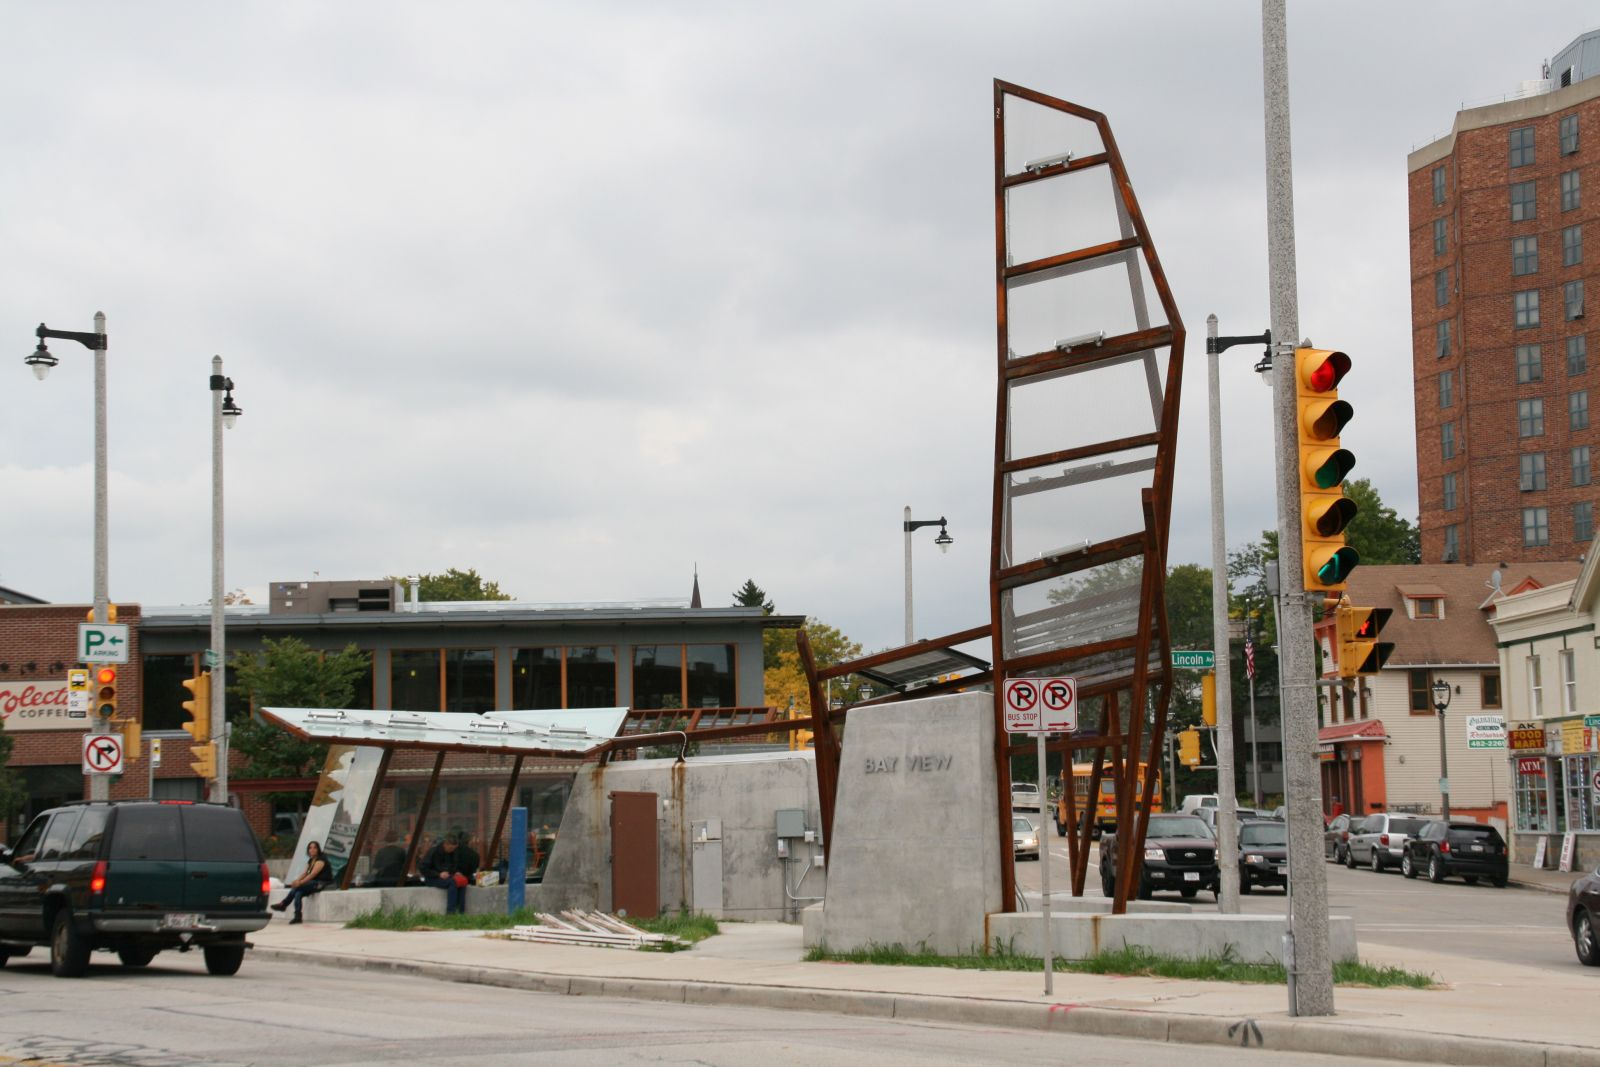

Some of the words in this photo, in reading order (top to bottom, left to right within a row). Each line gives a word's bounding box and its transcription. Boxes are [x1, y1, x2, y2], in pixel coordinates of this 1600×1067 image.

[1171, 653, 1204, 665] Lincoln
[1513, 731, 1541, 740] FOOD
[1514, 740, 1541, 749] MART
[865, 756, 899, 774] BAY
[905, 753, 953, 773] VIEW
[1520, 761, 1541, 772] ATM
